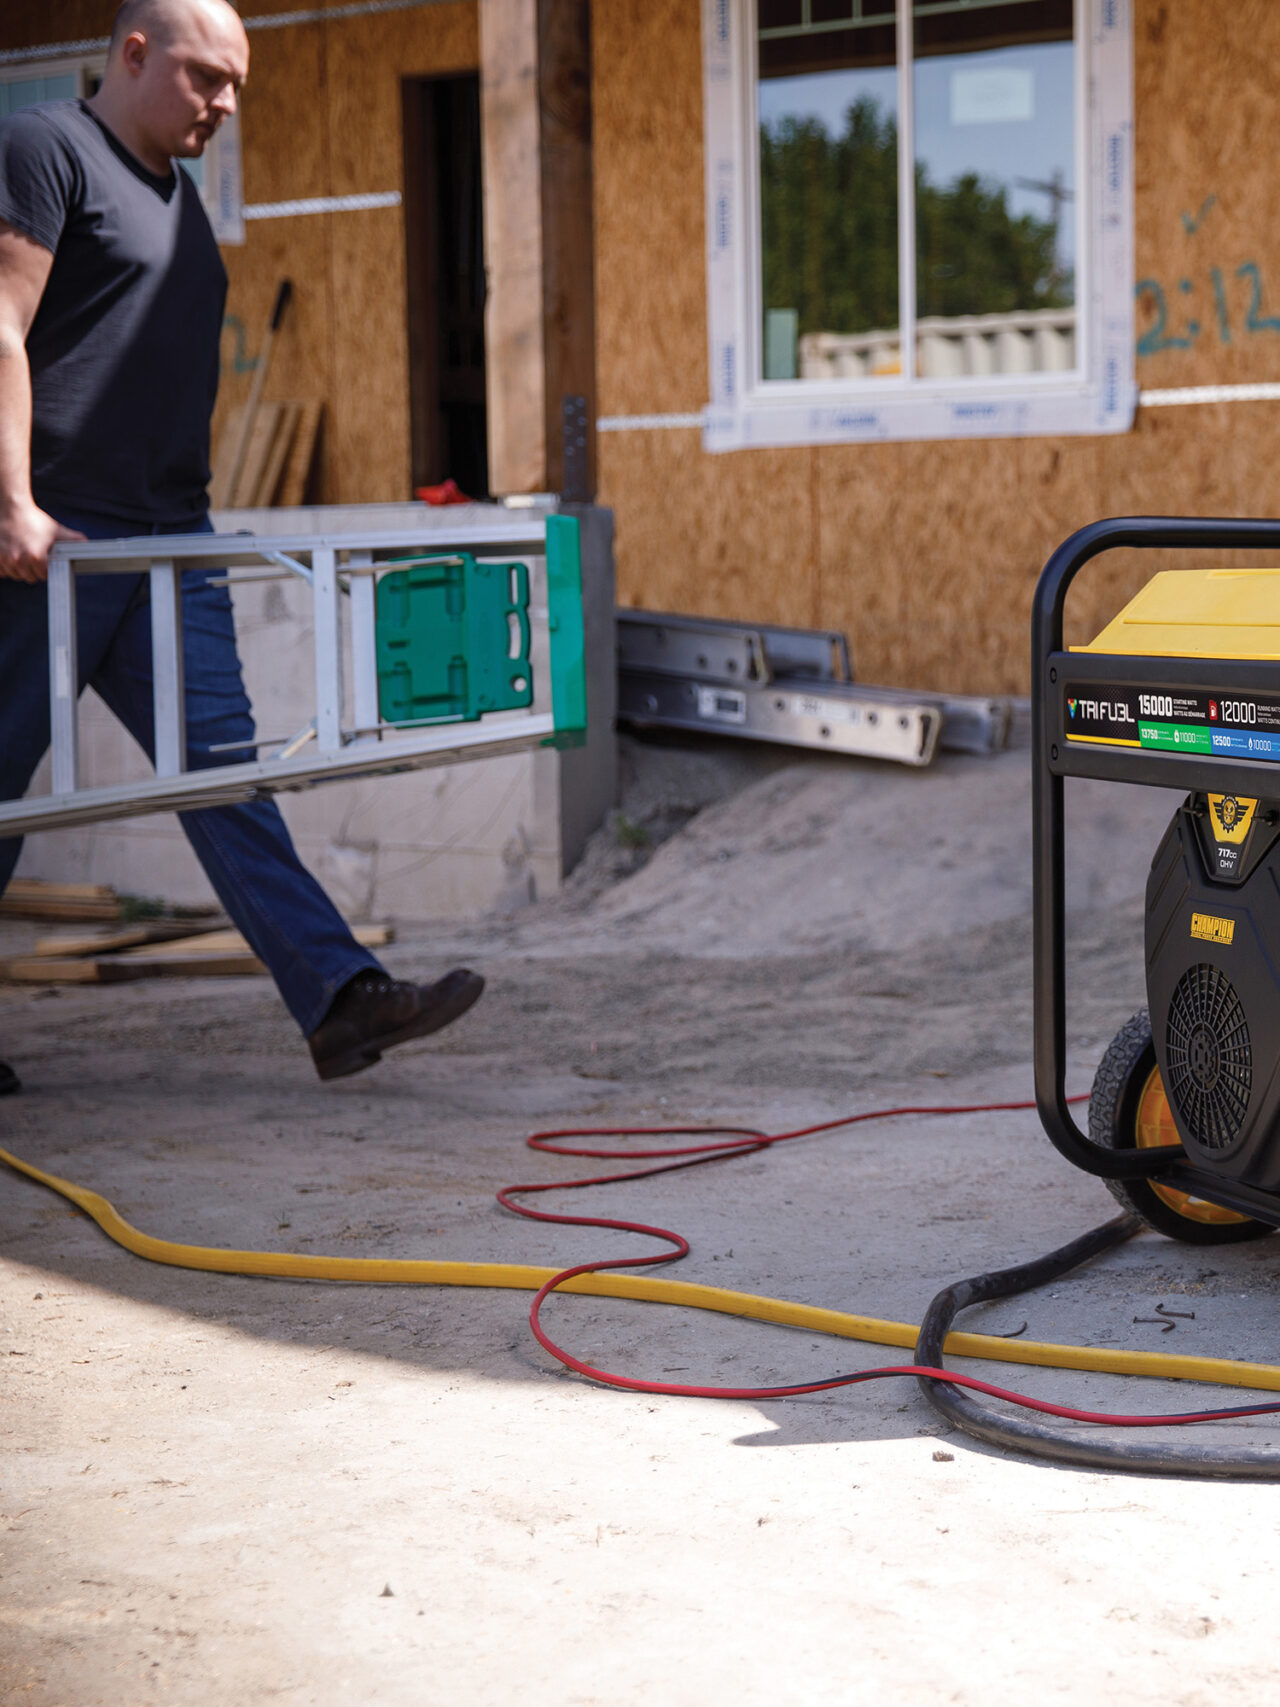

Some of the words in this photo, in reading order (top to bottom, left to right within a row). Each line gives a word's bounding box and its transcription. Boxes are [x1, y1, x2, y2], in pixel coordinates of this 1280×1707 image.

[1138, 694, 1172, 716] 15000
[1220, 701, 1256, 724] 12000
[1141, 728, 1158, 739] 13750
[1180, 732, 1196, 743] 11000
[1212, 735, 1231, 746] 12500
[1253, 739, 1272, 751] 10000
[1220, 860, 1233, 868] OHV
[1191, 914, 1235, 939] CHAMPION
